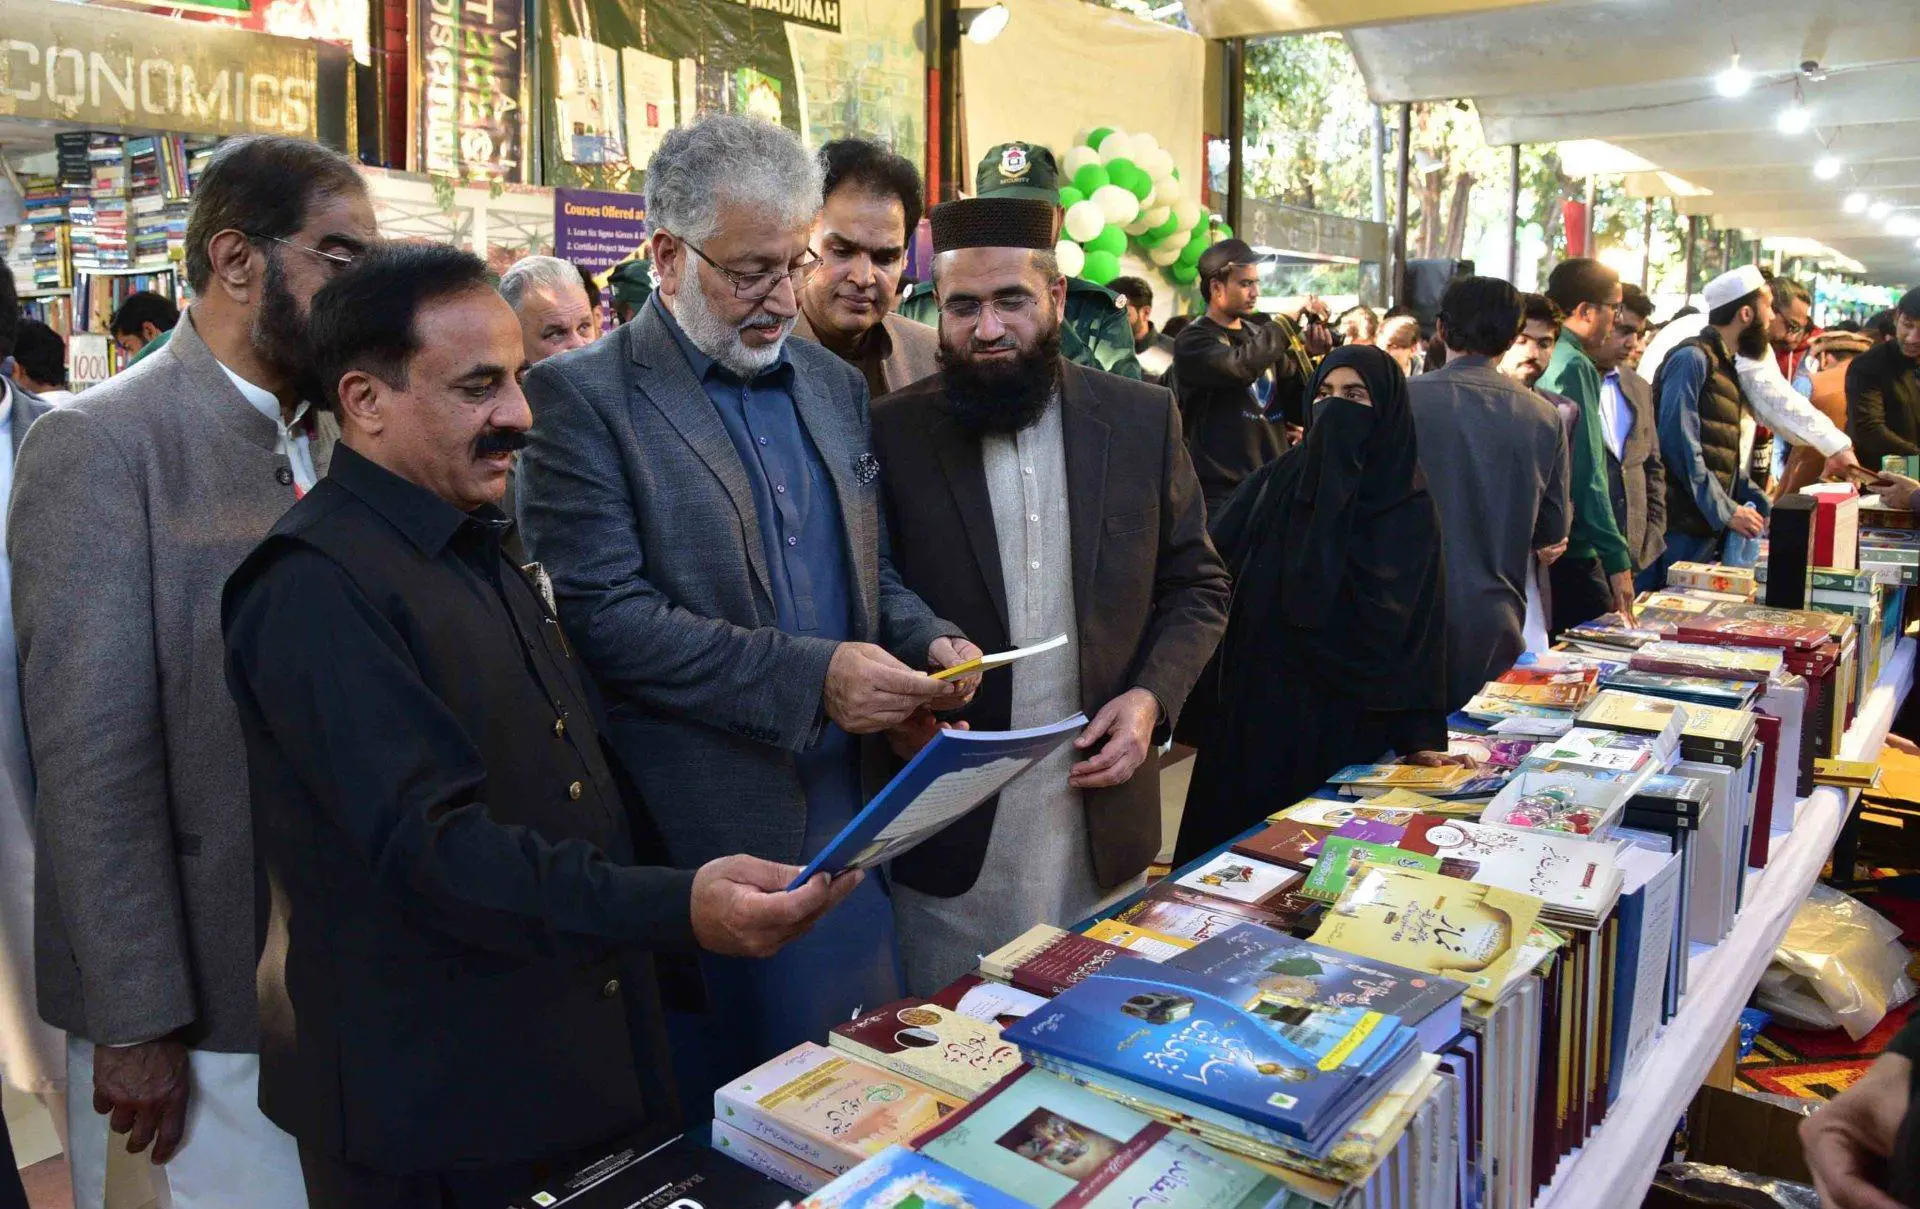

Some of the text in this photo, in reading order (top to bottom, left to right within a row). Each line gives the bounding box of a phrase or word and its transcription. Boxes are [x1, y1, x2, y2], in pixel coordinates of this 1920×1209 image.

[564, 202, 600, 217] Courses
[602, 204, 633, 219] Offered
[573, 243, 597, 251] Certified
[599, 244, 617, 253] Project
[74, 356, 106, 379] 1000
[1433, 915, 1467, 952] نماز
[1143, 1039, 1188, 1075] بنیادی
[1172, 1020, 1220, 1044] باتیں
